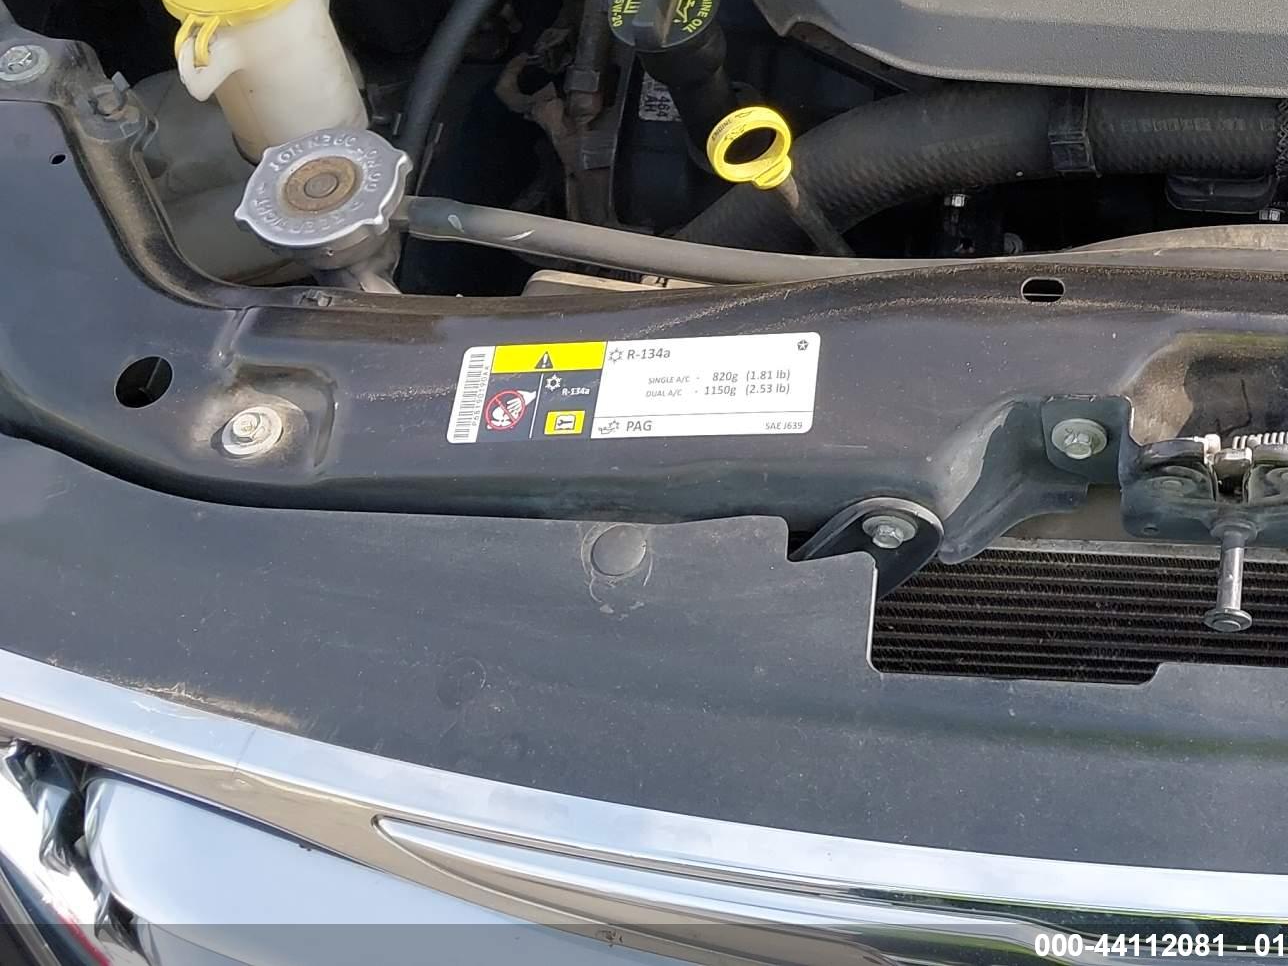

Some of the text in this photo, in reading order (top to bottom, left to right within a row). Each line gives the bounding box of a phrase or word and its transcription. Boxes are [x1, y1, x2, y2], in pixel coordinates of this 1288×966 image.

[682, 17, 703, 34] OIL
[627, 347, 671, 360] R-134a
[648, 376, 675, 385] SINGLE
[676, 375, 691, 384] A/C
[712, 371, 739, 383] 820g
[745, 369, 773, 382] (1.81
[775, 369, 791, 381] lb)
[561, 387, 591, 396] R-134a
[645, 390, 667, 398] DUAL
[668, 388, 683, 397] A/C
[704, 384, 737, 397] 1150g
[745, 384, 773, 396] (2.53
[775, 383, 791, 395] lb)
[626, 420, 653, 433] PAG
[765, 421, 803, 431] SAE J639
